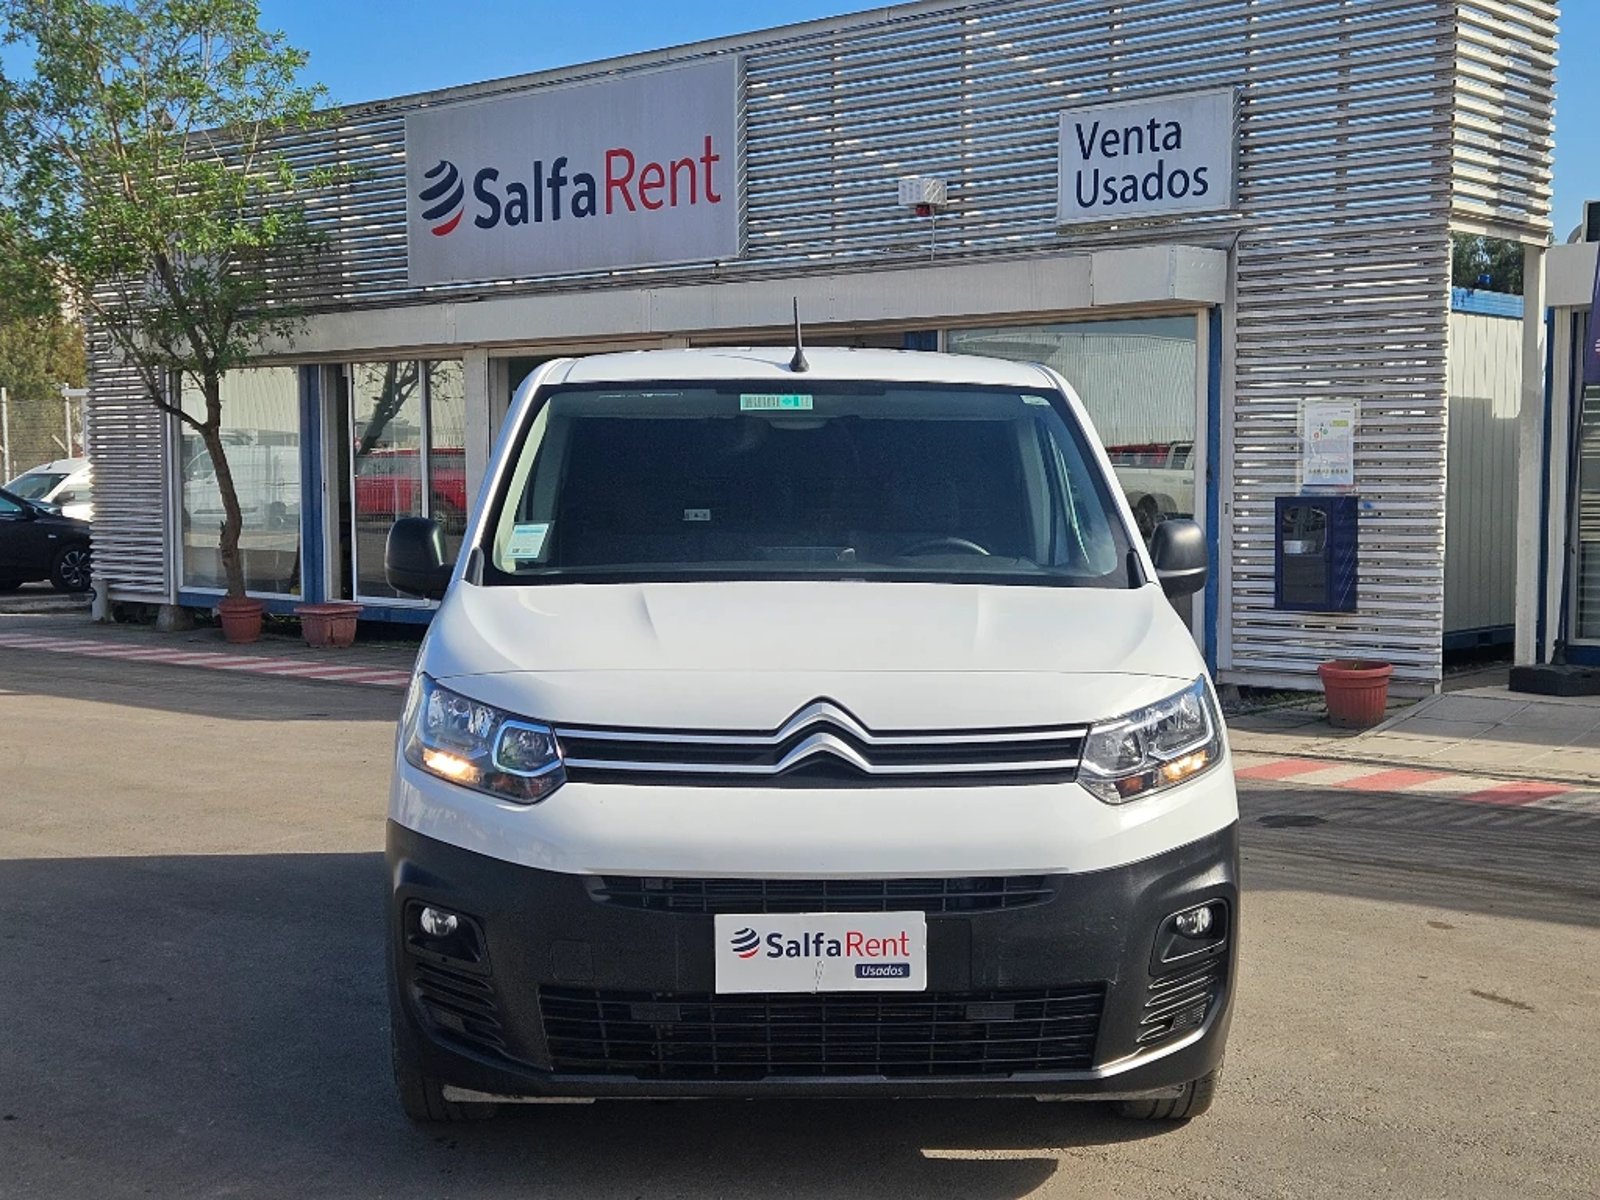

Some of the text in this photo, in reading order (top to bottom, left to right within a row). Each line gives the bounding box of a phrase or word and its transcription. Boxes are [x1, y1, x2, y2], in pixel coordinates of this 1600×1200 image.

[1075, 117, 1182, 160] Venta
[473, 135, 721, 229] SalfaRent
[1076, 159, 1209, 208] Usados
[766, 931, 910, 958] SalfaRent
[861, 965, 904, 976] Usados
